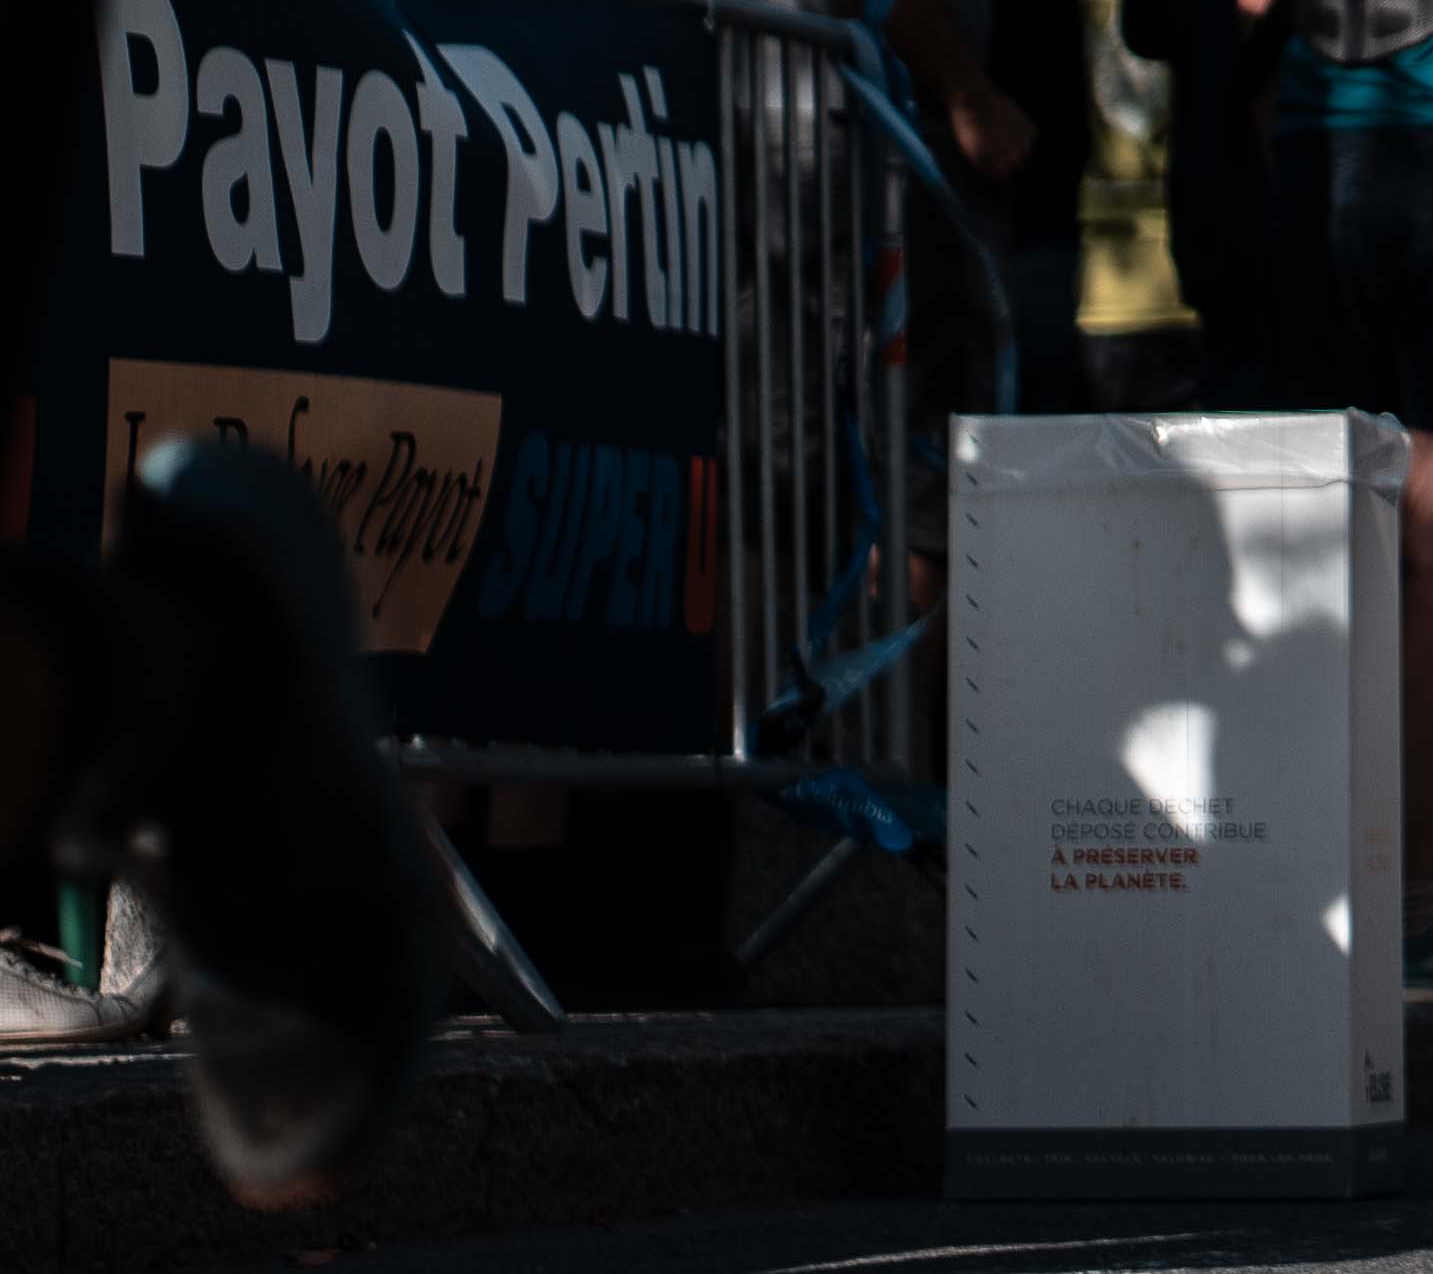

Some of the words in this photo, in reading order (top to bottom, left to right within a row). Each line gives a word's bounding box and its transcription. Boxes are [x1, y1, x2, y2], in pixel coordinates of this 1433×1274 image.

[437, 43, 717, 336] Pertin
[352, 430, 483, 620] Payot
[478, 430, 681, 631] SUPER
[684, 455, 718, 634] U
[1051, 798, 1143, 816] CHAQUE
[1051, 820, 1137, 840] DÉPOSÉ
[1143, 821, 1267, 840] CONTRIBUE
[1051, 845, 1066, 865] À
[1073, 846, 1200, 865] PRÉSERVER
[1051, 873, 1079, 890] LA
[1085, 868, 1187, 890] PLANÈTE.
